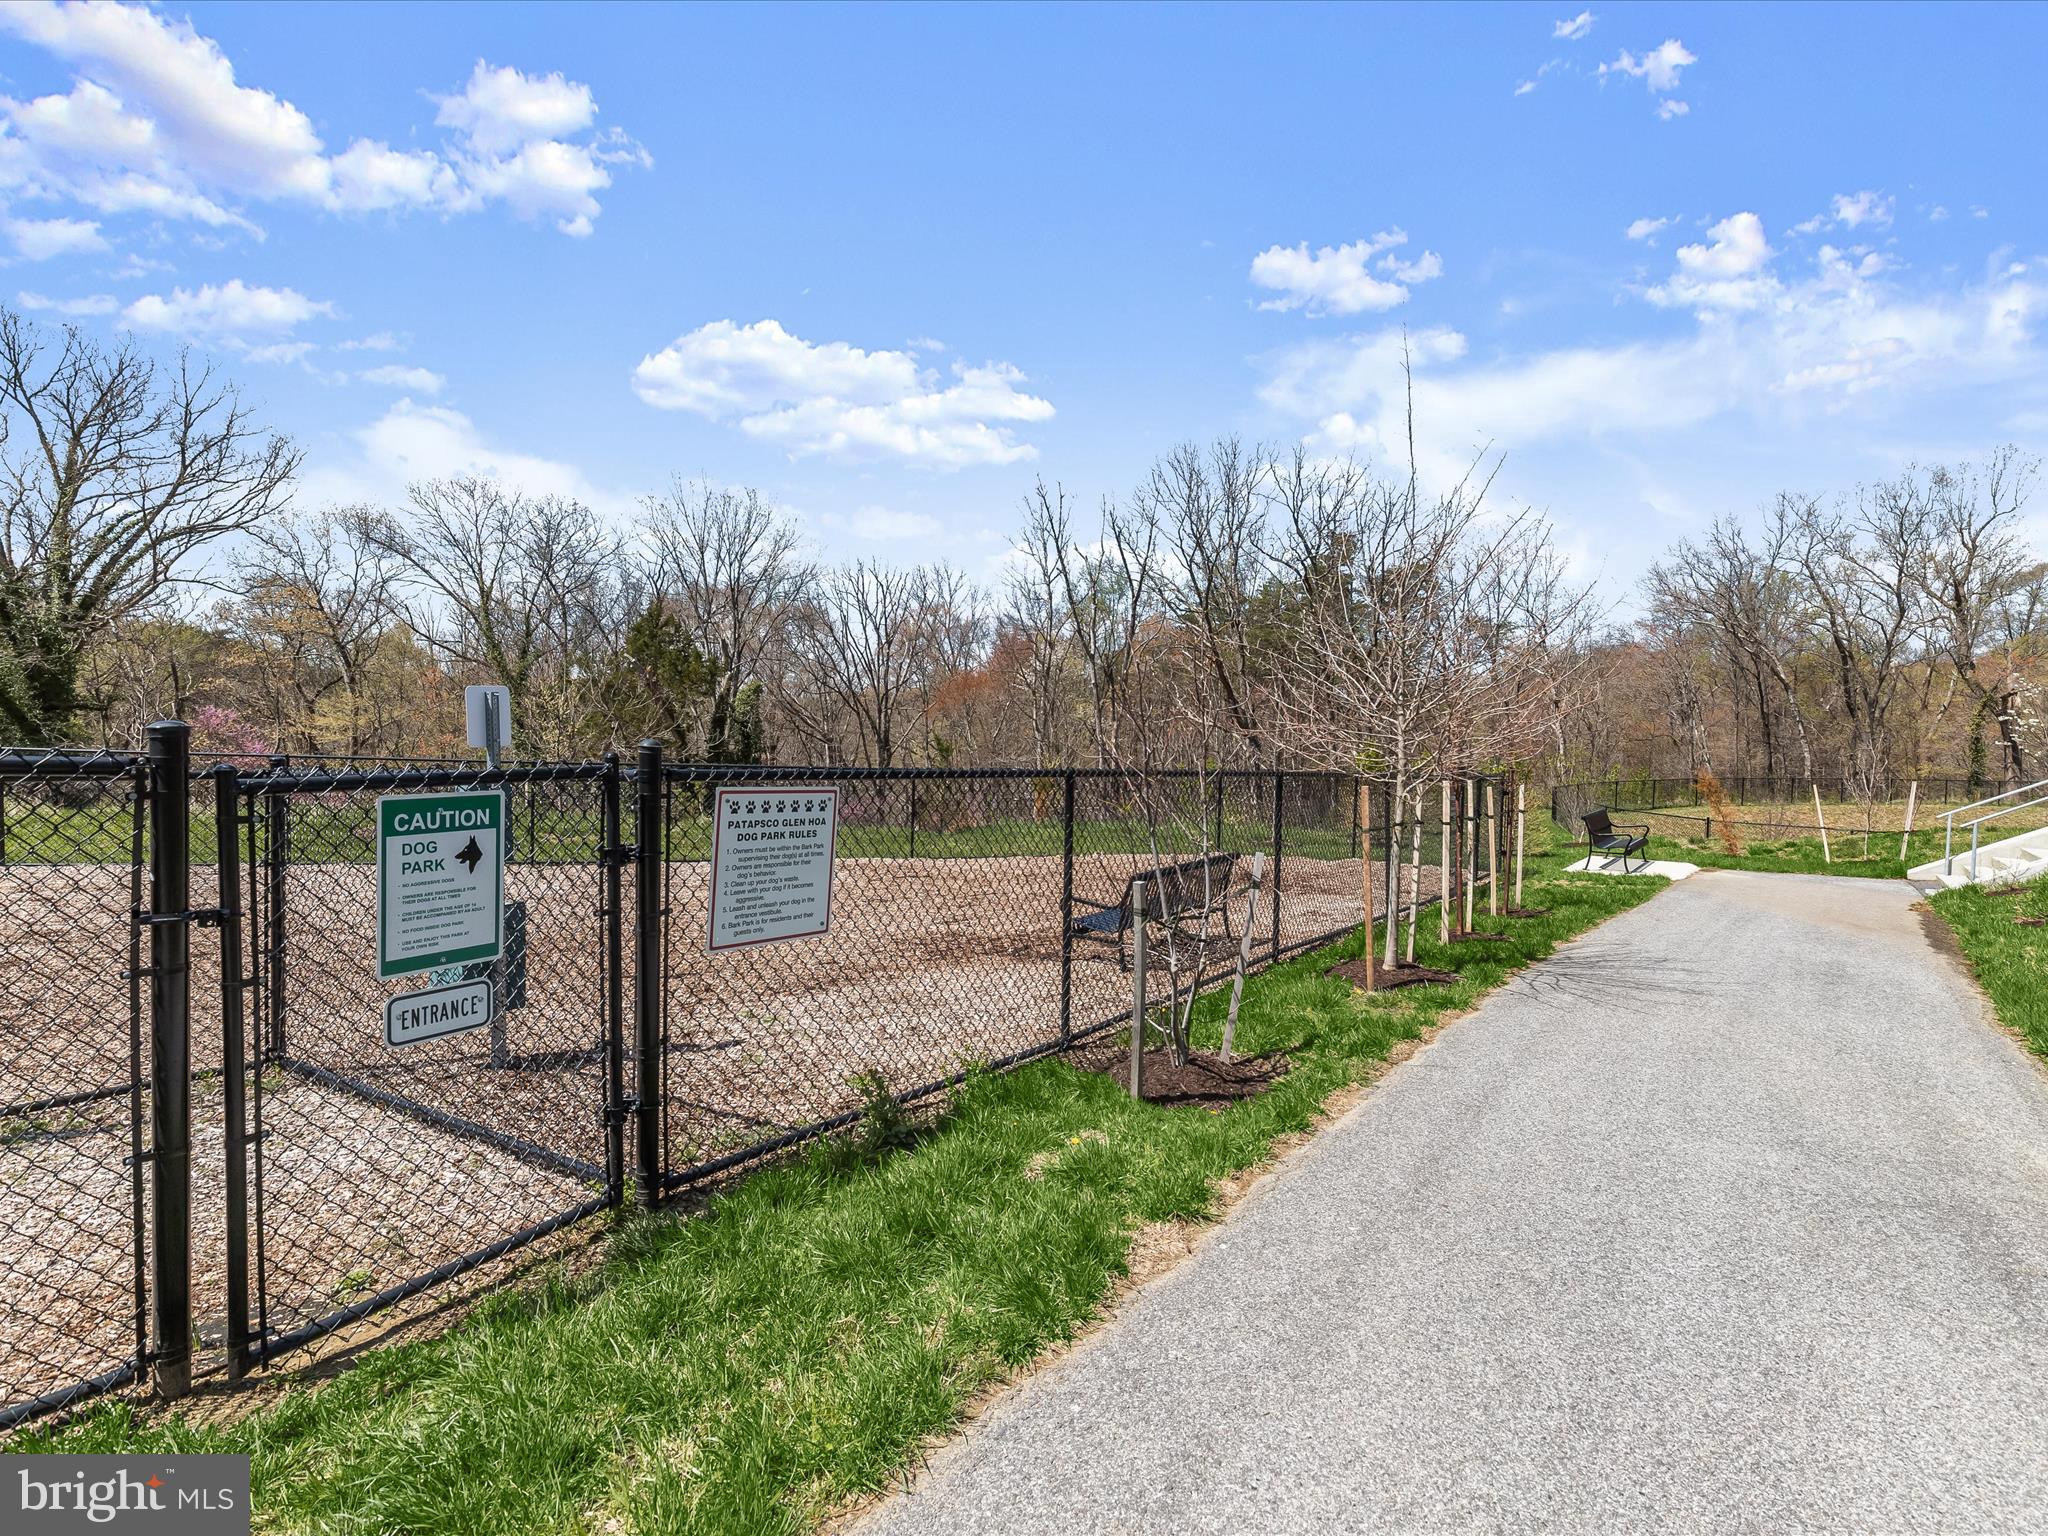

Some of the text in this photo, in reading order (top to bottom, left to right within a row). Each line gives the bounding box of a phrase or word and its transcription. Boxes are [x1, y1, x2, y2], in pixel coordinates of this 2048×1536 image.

[394, 808, 489, 831] CAUTION
[728, 819, 779, 829] PATAPSCO
[782, 819, 805, 827] GLEN
[737, 830, 817, 841] DOG PARK RULES
[402, 841, 437, 855] DOG
[738, 854, 769, 862] supervising
[402, 858, 445, 875] PARK
[763, 860, 792, 869] responsible
[737, 871, 752, 879] dog's
[736, 895, 764, 904] aggressive.
[728, 921, 741, 929] Bark
[769, 915, 792, 923] residents
[733, 928, 751, 937] guests
[402, 996, 478, 1030] ENTRANCE
